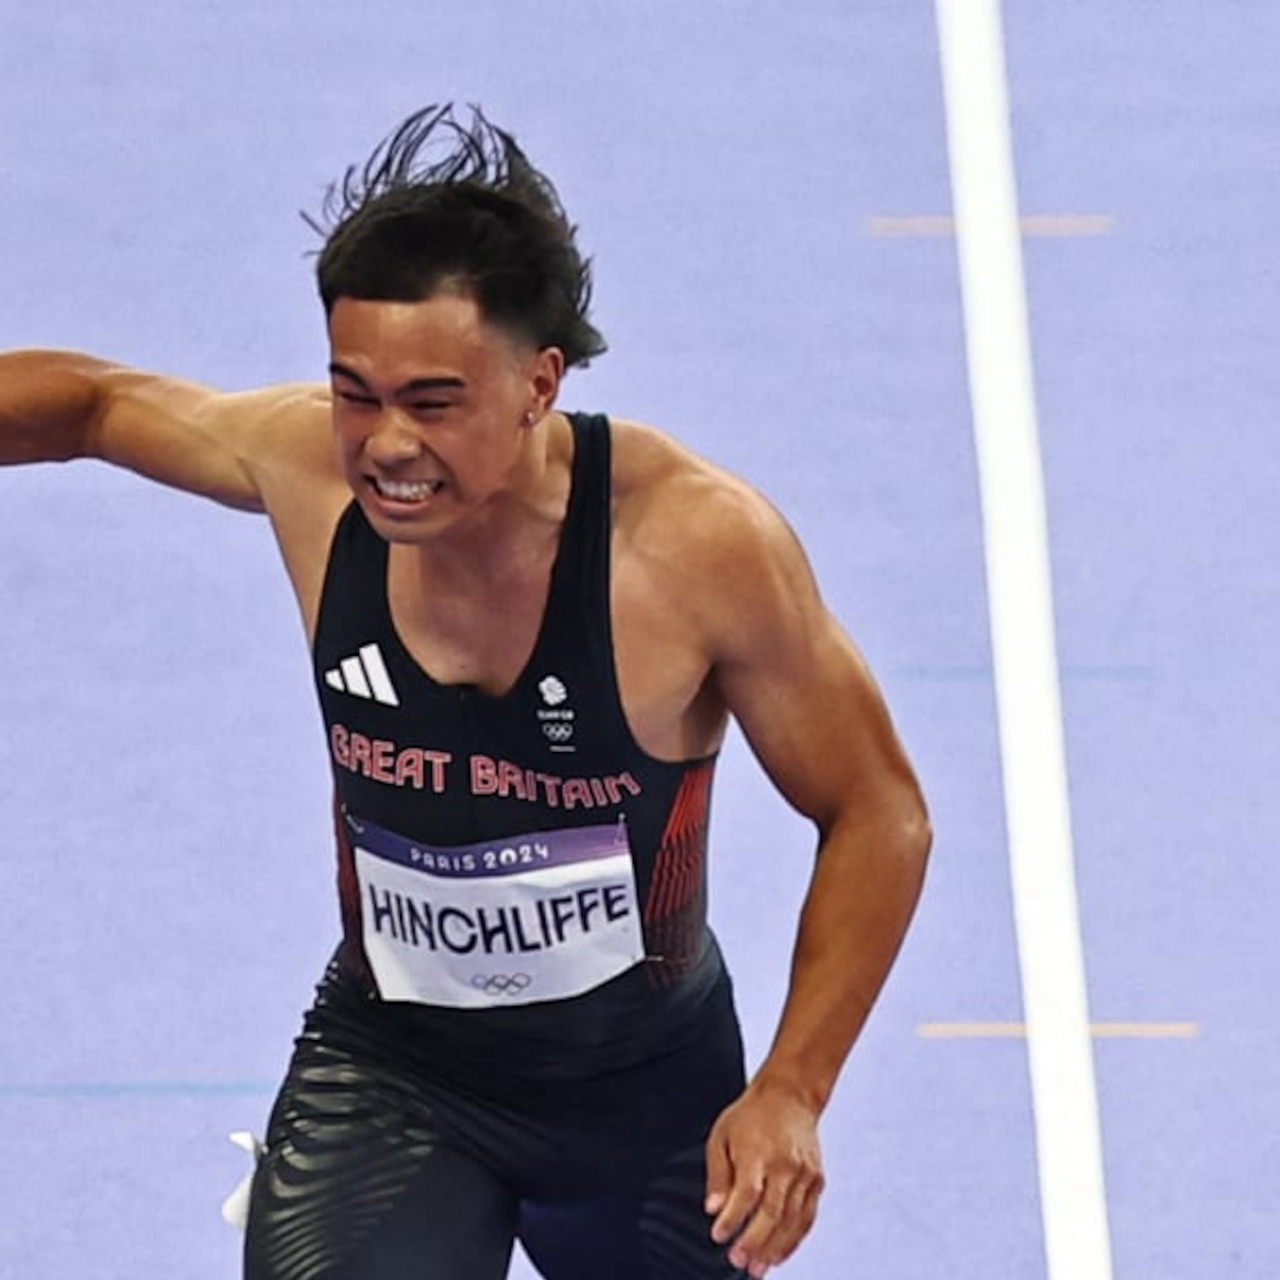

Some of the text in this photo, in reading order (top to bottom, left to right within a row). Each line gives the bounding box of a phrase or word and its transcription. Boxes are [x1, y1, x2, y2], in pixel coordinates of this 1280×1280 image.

[331, 724, 641, 810] GREAT BRITAIN
[410, 842, 549, 872] PARIS 2024
[369, 884, 629, 955] HINCHLIFFE
